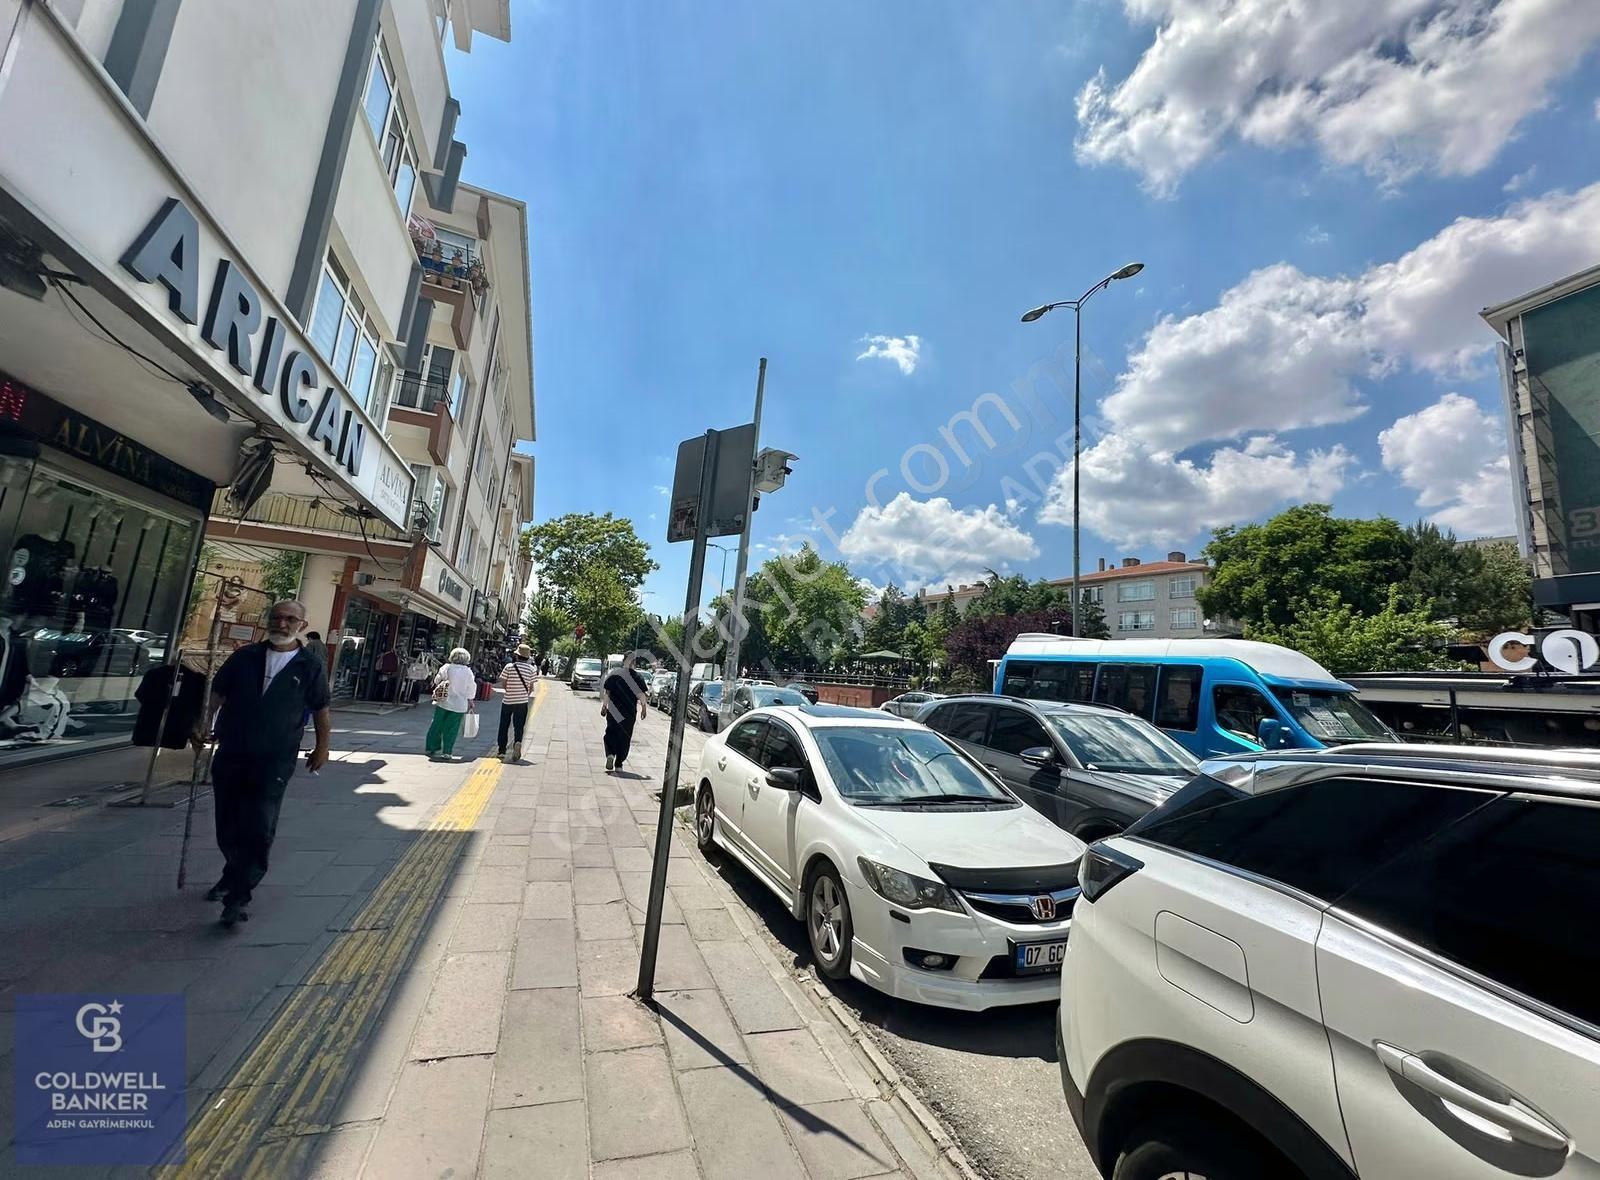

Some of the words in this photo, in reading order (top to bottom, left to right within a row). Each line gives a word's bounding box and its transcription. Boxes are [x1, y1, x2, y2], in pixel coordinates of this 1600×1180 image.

[119, 197, 366, 477] ARICAN
[1026, 947, 1041, 965] 07
[1049, 944, 1067, 962] GC
